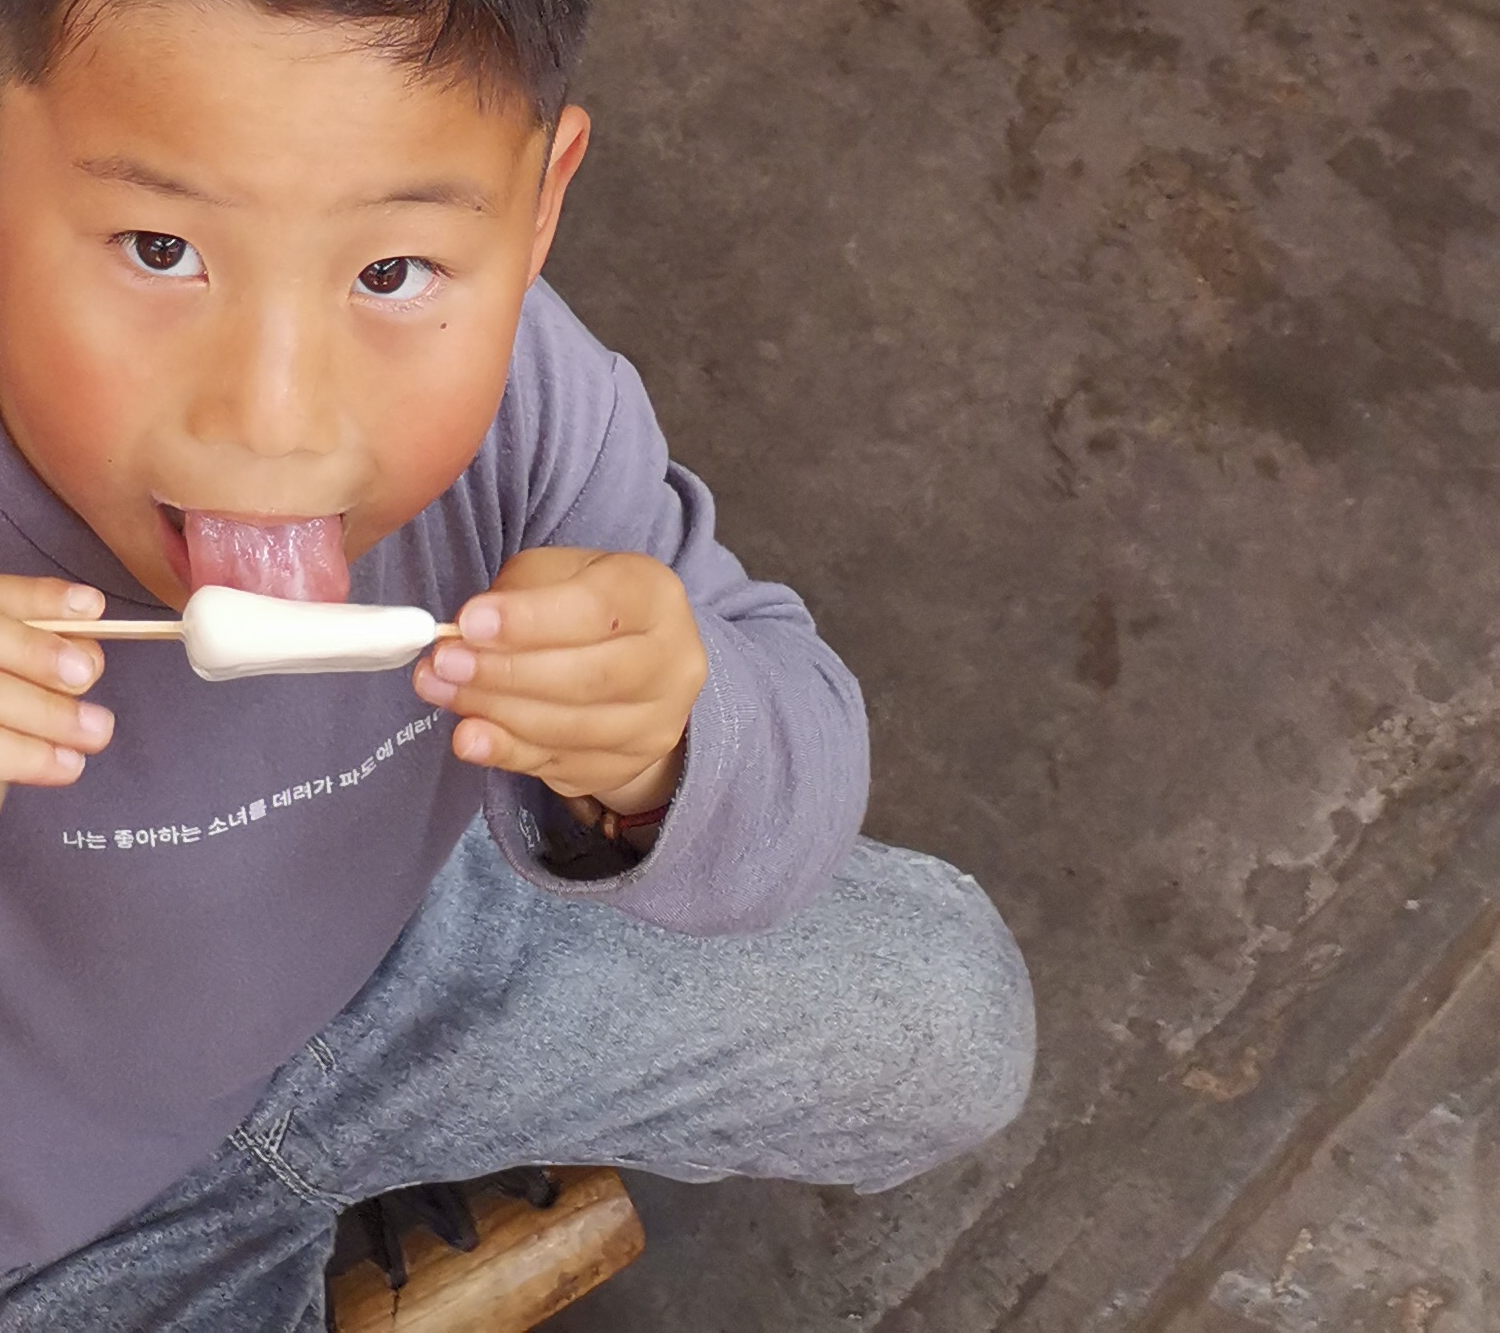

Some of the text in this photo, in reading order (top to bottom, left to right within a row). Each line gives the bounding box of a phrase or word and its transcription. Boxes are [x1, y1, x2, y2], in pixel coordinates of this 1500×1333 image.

[62, 830, 108, 850] 나는
[113, 824, 202, 850] 좋아하는
[207, 798, 268, 836] 소녀를
[272, 775, 334, 809] 데려가
[338, 738, 394, 788] 파도에
